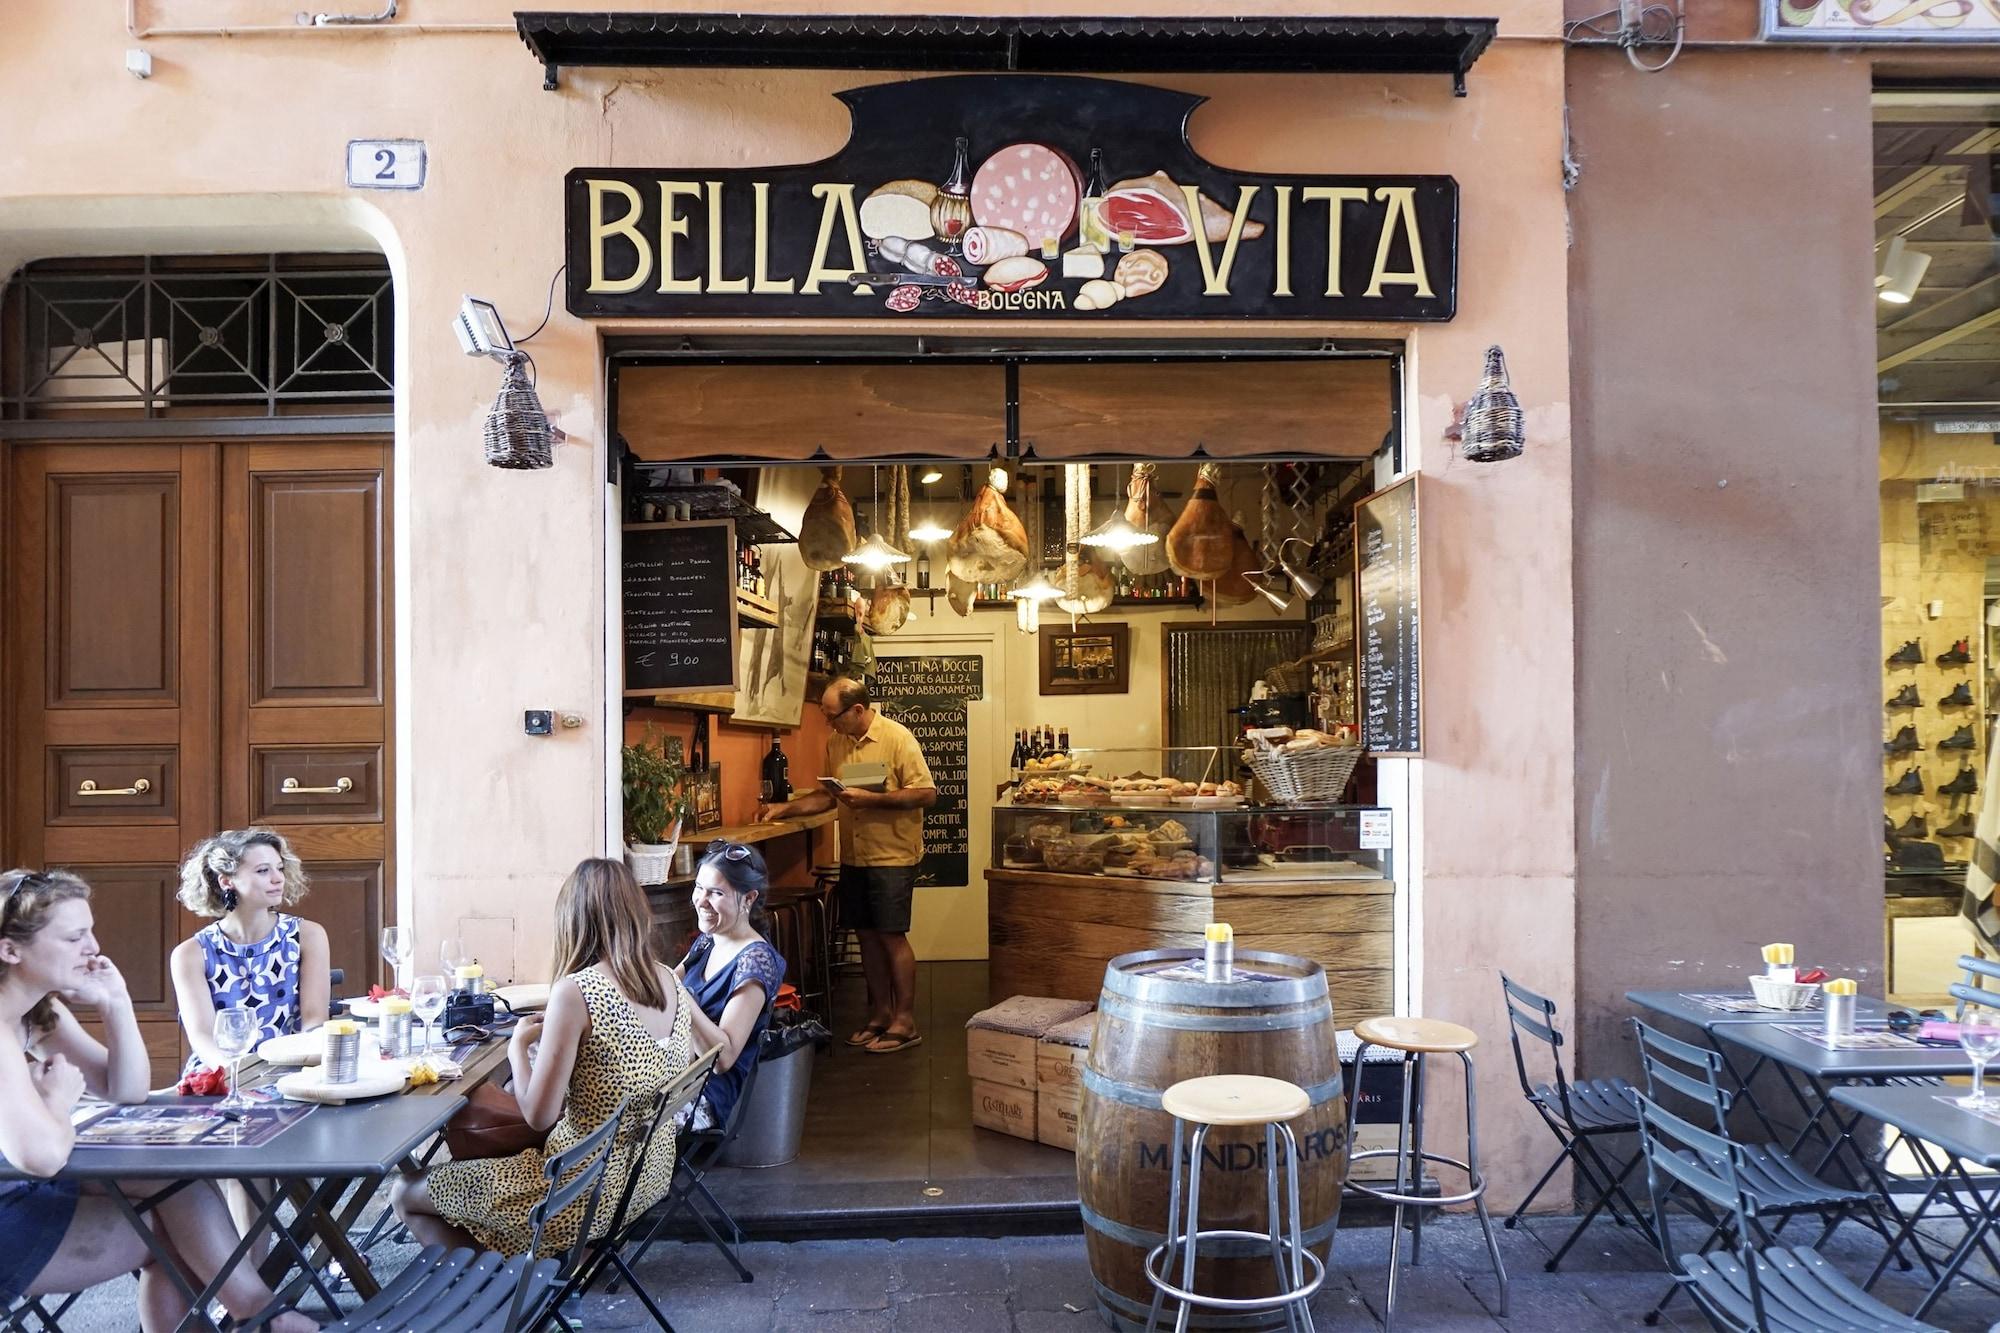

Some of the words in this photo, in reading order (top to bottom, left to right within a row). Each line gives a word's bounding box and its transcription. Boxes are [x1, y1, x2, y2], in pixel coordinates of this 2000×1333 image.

[375, 149, 396, 179] 2
[585, 179, 876, 296] BELLA
[1179, 185, 1438, 298] VITA
[977, 290, 1066, 310] BOLOGNA
[877, 674, 908, 684] DALLE
[909, 674, 926, 684] ORE
[926, 674, 934, 683] 6
[935, 674, 957, 684] ALLE
[958, 673, 971, 683] 24
[869, 686, 879, 696] SI
[881, 686, 915, 696] FANNO
[916, 684, 980, 696] ABBONAMENTI
[920, 712, 928, 722] A
[930, 711, 964, 722] DOCCIA
[938, 726, 967, 737] CALDA
